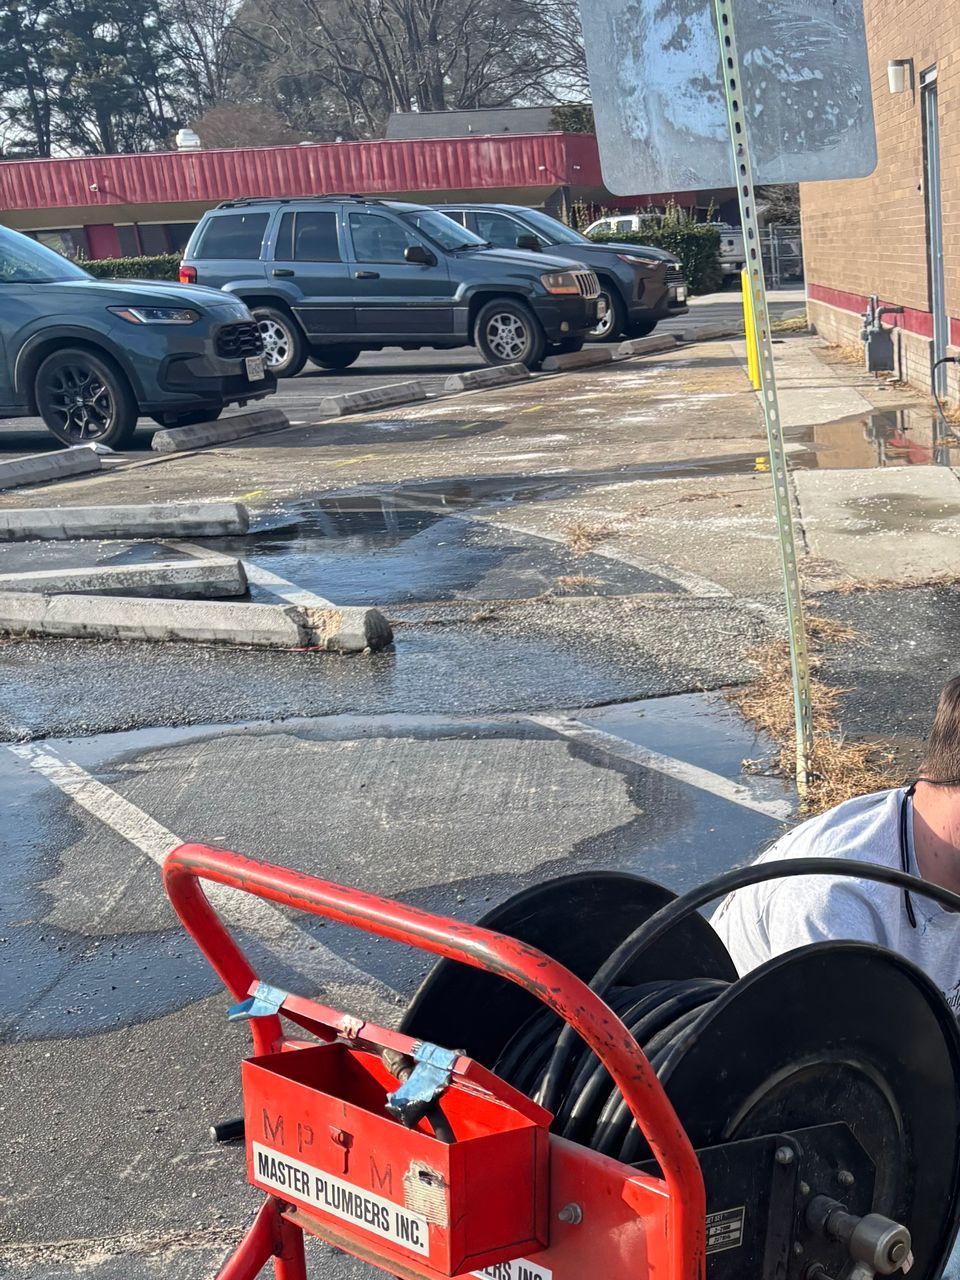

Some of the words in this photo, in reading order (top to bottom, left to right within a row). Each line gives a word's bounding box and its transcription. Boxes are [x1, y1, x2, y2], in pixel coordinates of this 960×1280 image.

[257, 1151, 311, 1197] MASTER
[315, 1176, 390, 1232] PLUMBERS
[395, 1212, 425, 1248] INC.
